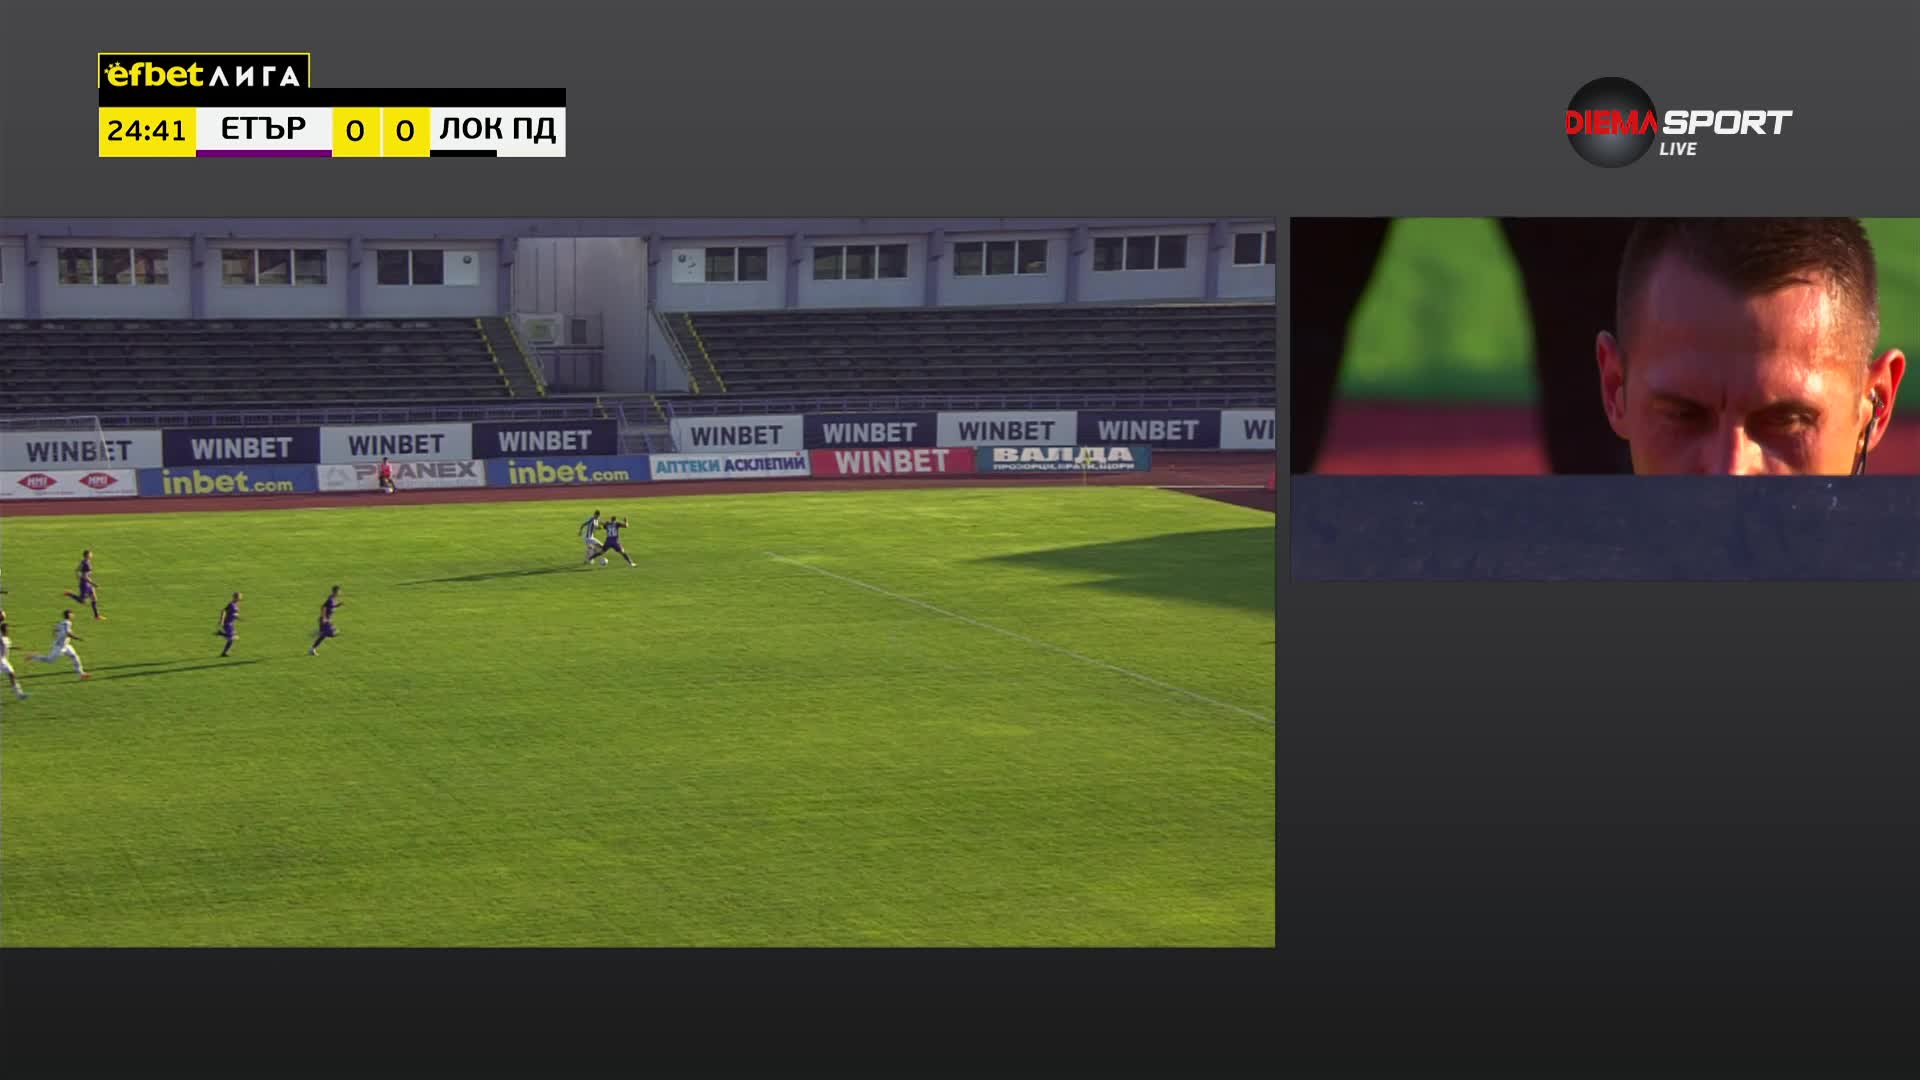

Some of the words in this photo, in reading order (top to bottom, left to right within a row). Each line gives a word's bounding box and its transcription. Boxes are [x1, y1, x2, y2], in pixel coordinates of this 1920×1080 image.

[498, 429, 593, 452] WINBET
[690, 425, 784, 447] WINBET
[822, 421, 918, 444] WINBET
[958, 420, 1056, 441] WINBET
[1097, 419, 1200, 441] WINBET
[26, 440, 132, 462] WINBET
[191, 436, 294, 460] WINBET
[348, 433, 445, 456] WINBET
[992, 447, 1134, 463] ВАЛДА
[353, 461, 477, 481] PANEX
[508, 460, 629, 484] inbet.com
[655, 458, 721, 474] АПТЕКИ
[724, 456, 806, 473] АСКЛЕПИЙ
[834, 449, 949, 474] WINBET
[163, 469, 294, 494] inbet.com
